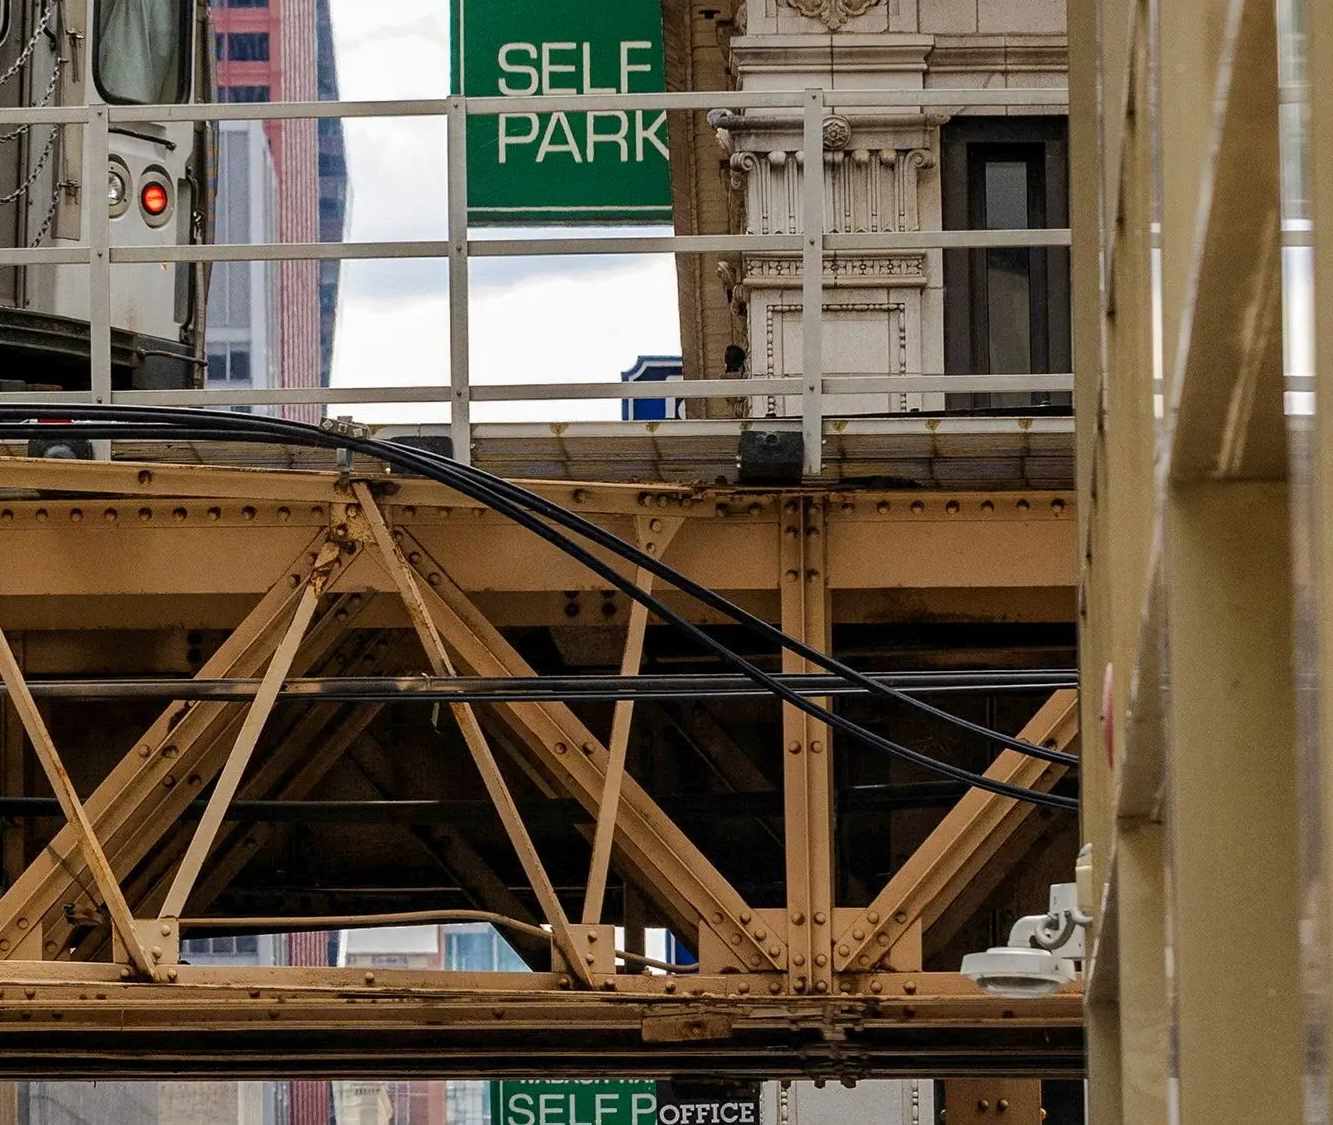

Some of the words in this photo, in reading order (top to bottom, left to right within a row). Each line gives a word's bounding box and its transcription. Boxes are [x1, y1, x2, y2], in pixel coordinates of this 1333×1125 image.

[497, 40, 653, 96] SELF
[497, 110, 670, 164] PARK
[507, 1092, 620, 1125] SELF
[631, 1092, 658, 1125] P
[659, 1101, 755, 1125] OFFICE
